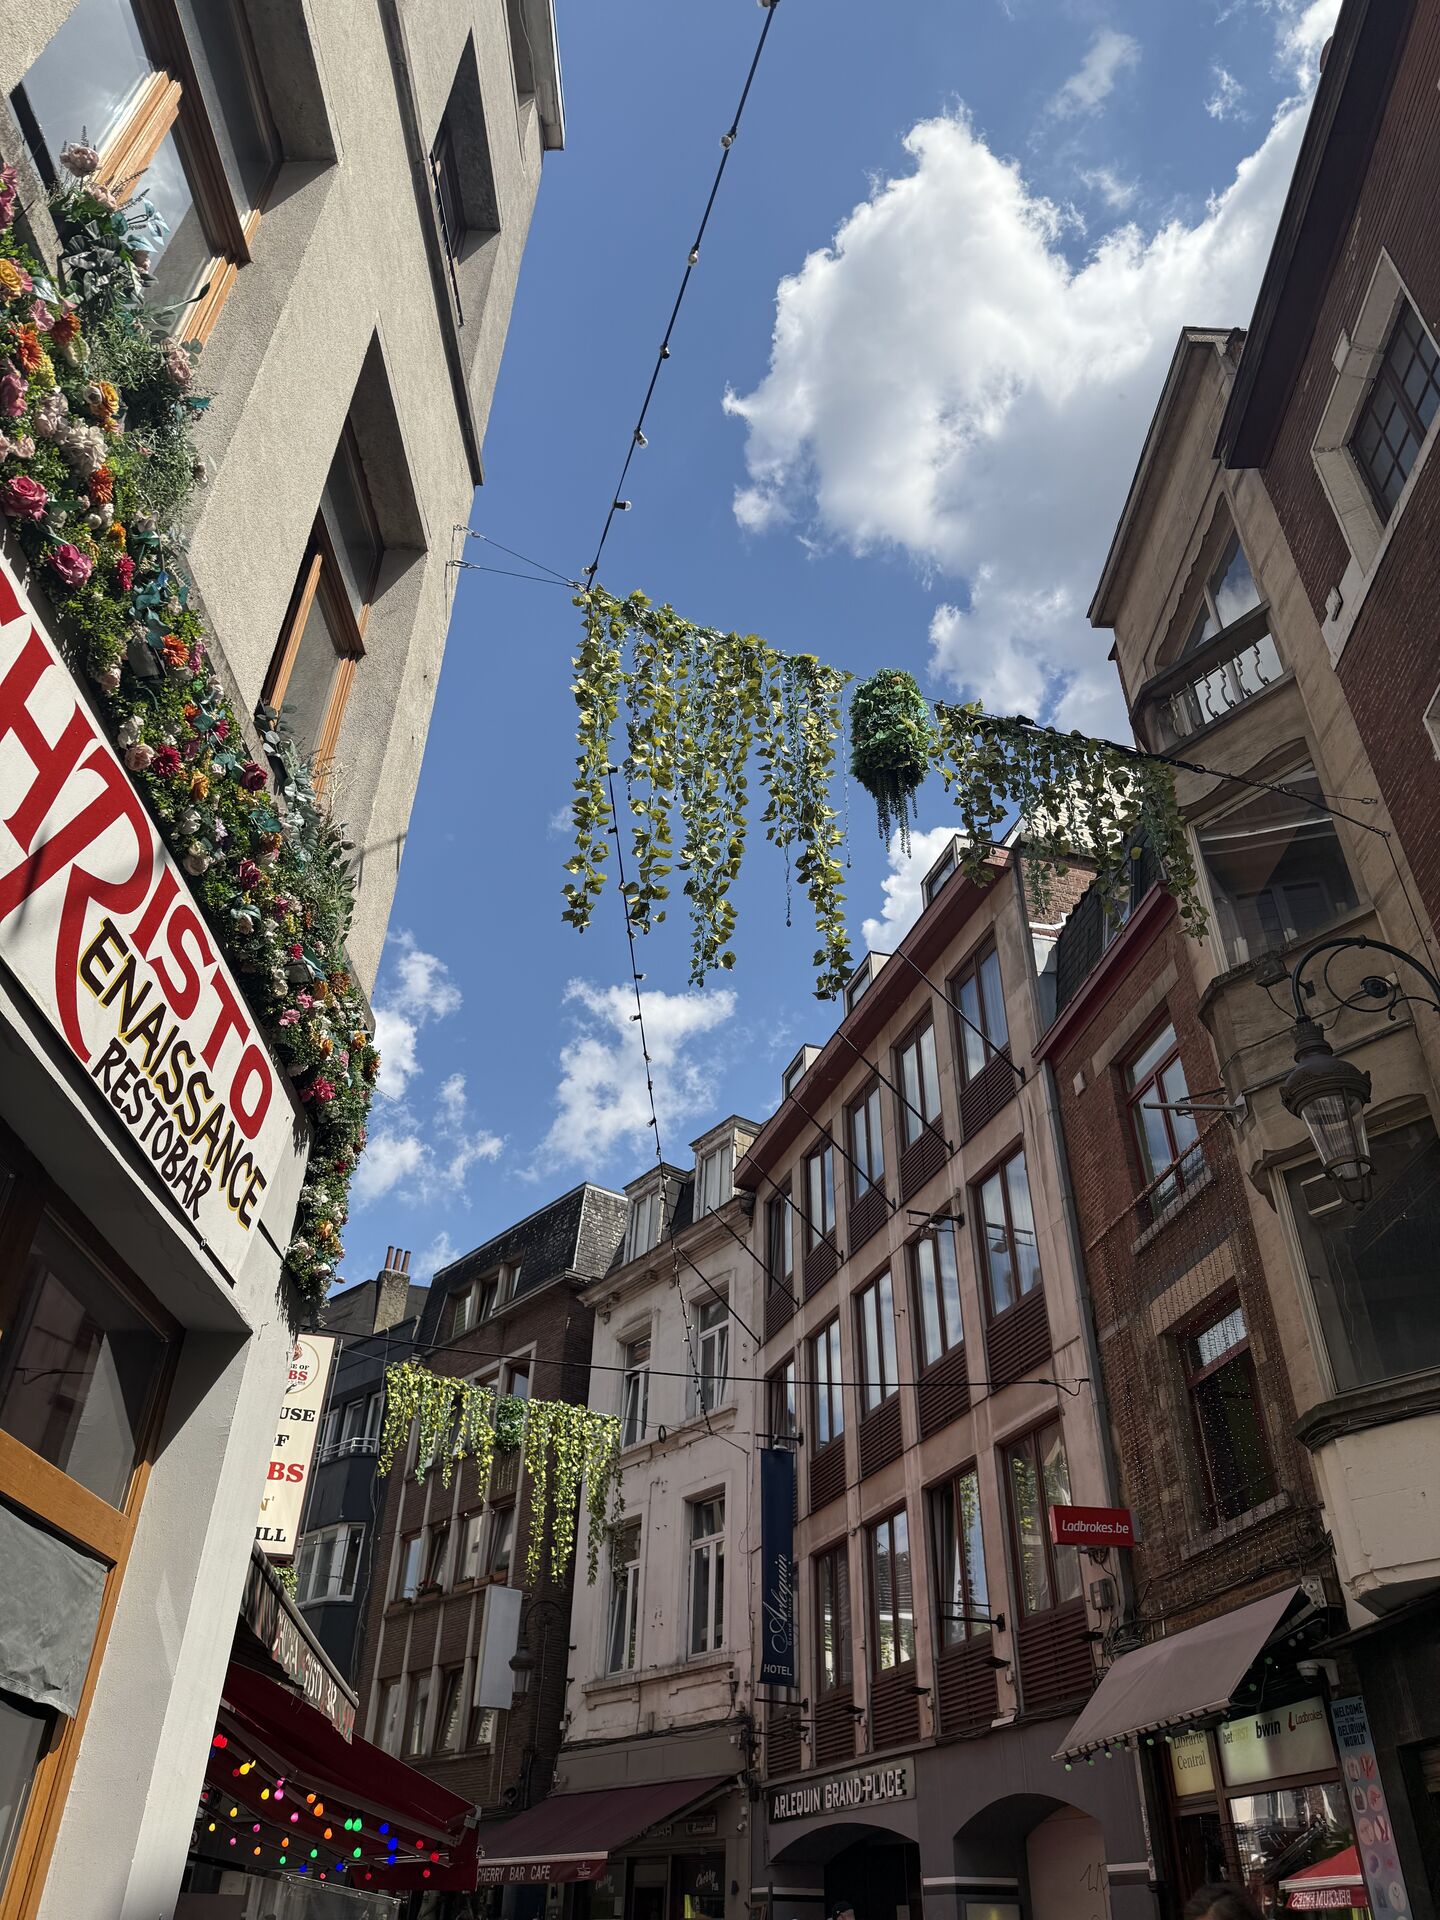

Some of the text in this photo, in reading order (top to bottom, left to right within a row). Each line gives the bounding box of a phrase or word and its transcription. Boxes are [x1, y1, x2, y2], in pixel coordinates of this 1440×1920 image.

[0, 568, 274, 1140] HRISTO
[91, 1037, 213, 1221] RESTOBAR
[288, 1370, 308, 1381] BS
[273, 1434, 290, 1447] F
[266, 1461, 305, 1483] BS
[254, 1526, 286, 1542] ILL
[1061, 1519, 1130, 1534] Ladbrokes.be
[762, 1552, 793, 1654] Arlequin
[763, 1663, 793, 1676] HOTEL
[1333, 1703, 1364, 1718] WELCOME
[1255, 1717, 1281, 1738] bwin
[1295, 1709, 1324, 1725] Ladbrokes
[1337, 1721, 1367, 1737] DELIRIUM
[1343, 1734, 1366, 1747] WORLD
[1177, 1751, 1207, 1770] Central
[773, 1768, 904, 1819] ARLEQUIN GRAND-PLACE
[477, 1864, 551, 1883] CHERRY BAR CAFE
